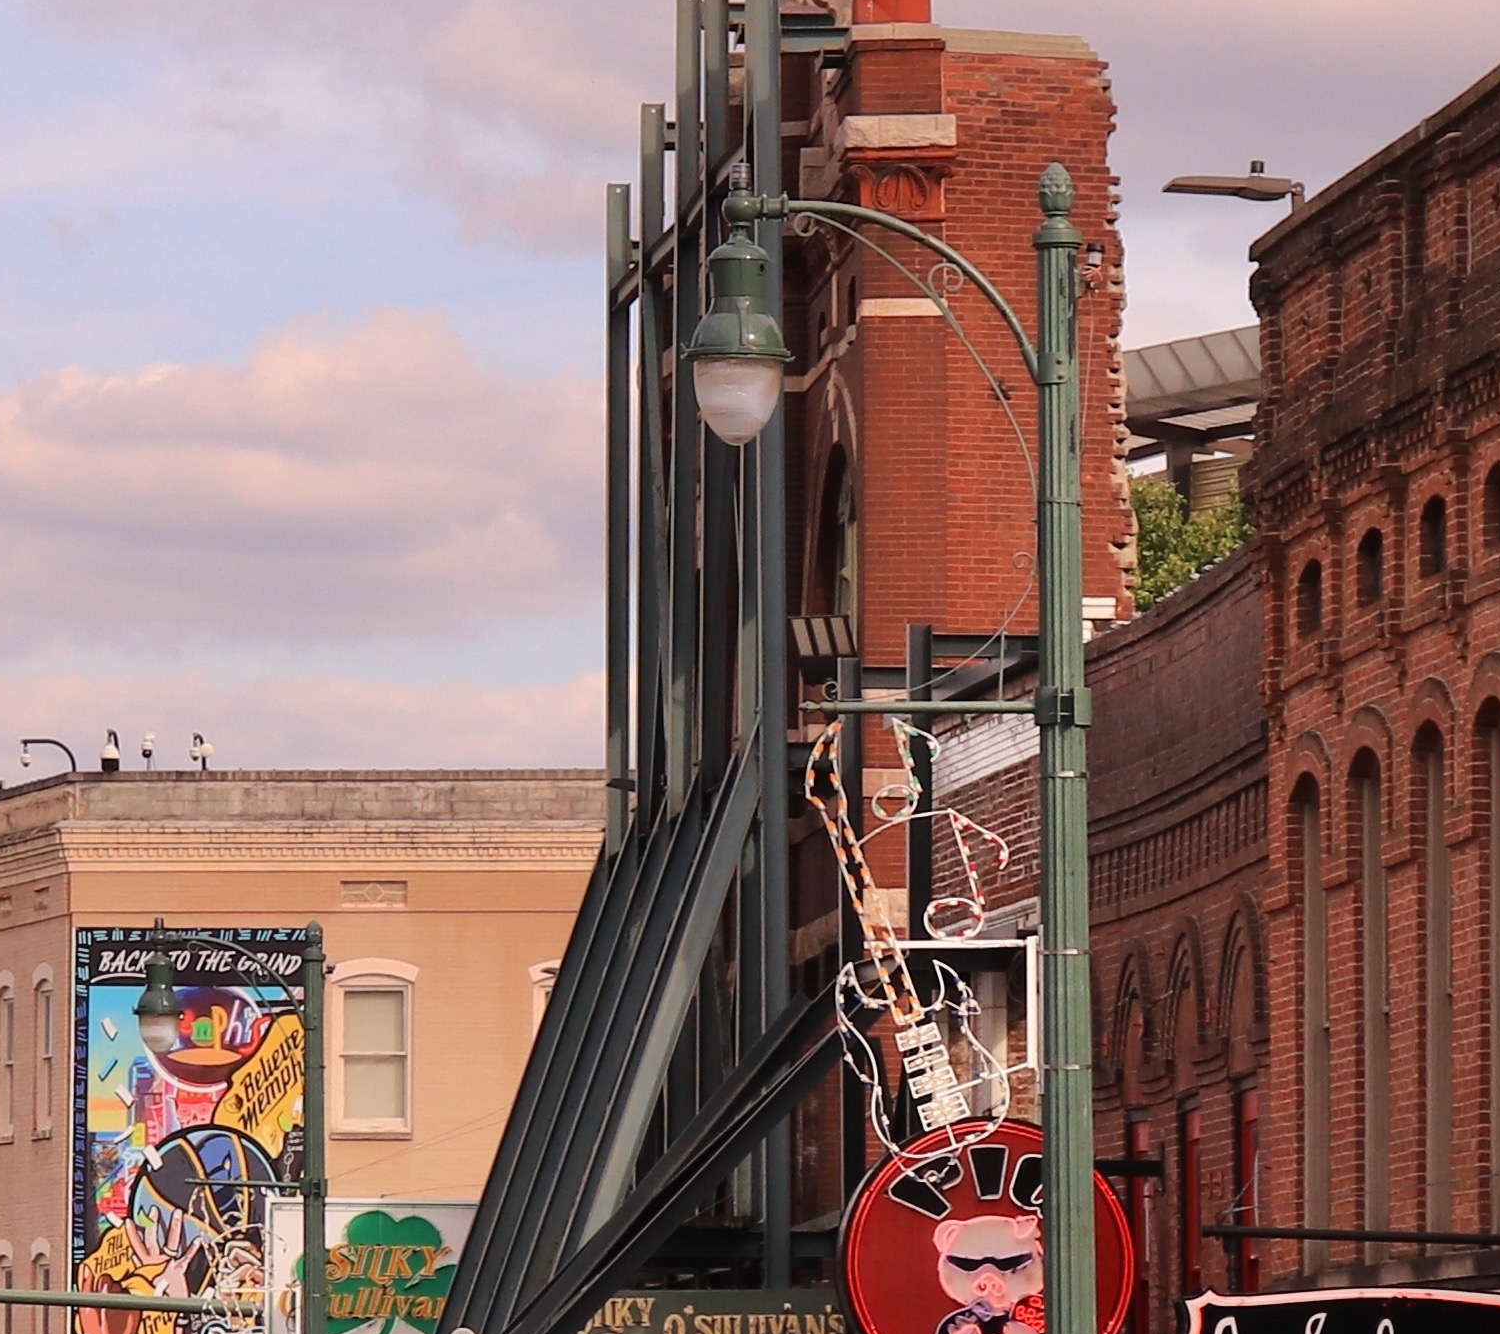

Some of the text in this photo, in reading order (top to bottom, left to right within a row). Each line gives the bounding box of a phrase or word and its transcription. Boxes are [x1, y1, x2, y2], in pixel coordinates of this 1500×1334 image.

[99, 950, 302, 976] BACK TO THE GRIND
[94, 1247, 133, 1275] Heart
[325, 1244, 452, 1284] SILKY
[278, 1285, 447, 1318] Oulliva
